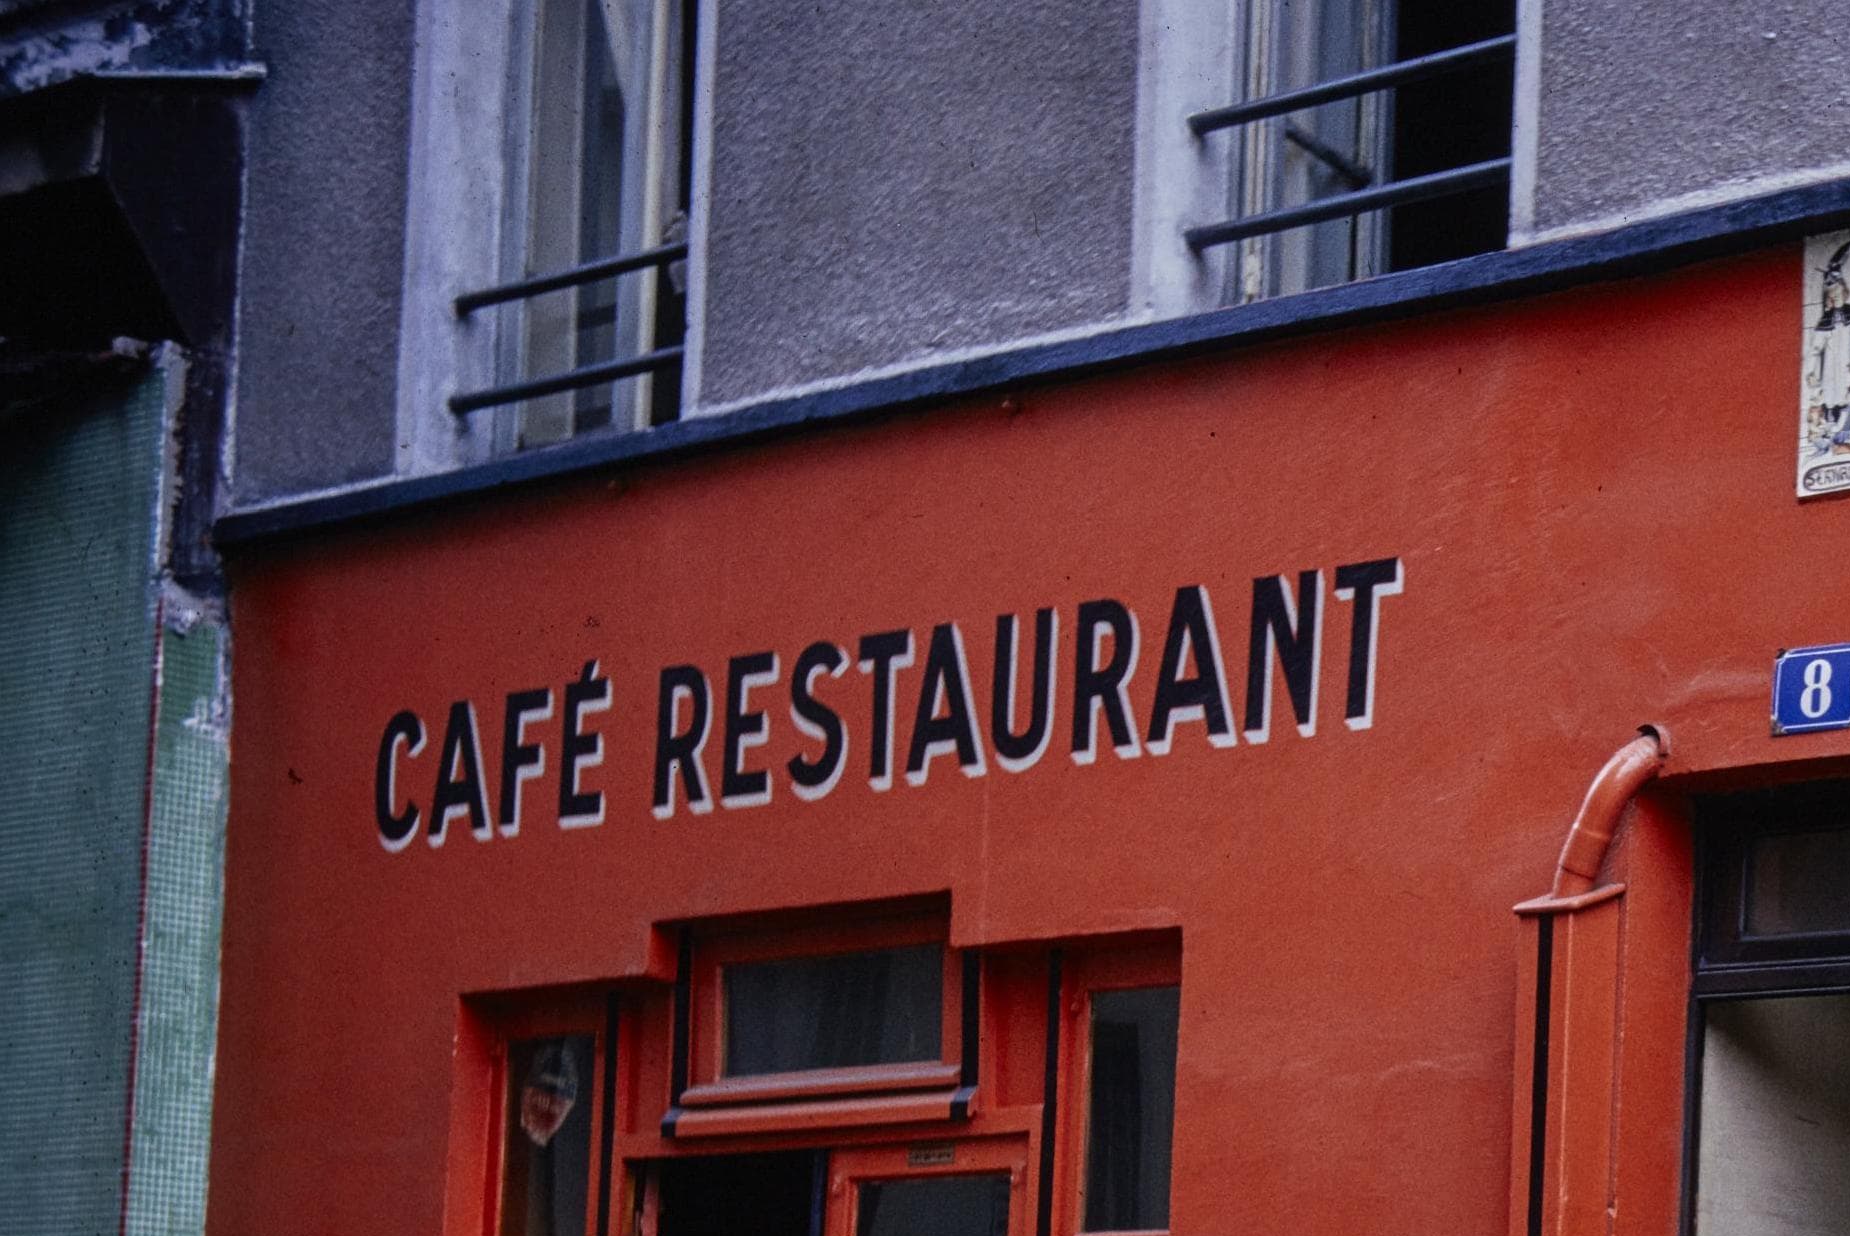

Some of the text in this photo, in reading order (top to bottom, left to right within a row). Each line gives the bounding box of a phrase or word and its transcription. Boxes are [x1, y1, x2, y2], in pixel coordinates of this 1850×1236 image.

[375, 556, 1404, 853] CAFÉ RESTAURANT
[1800, 657, 1833, 719] 8
